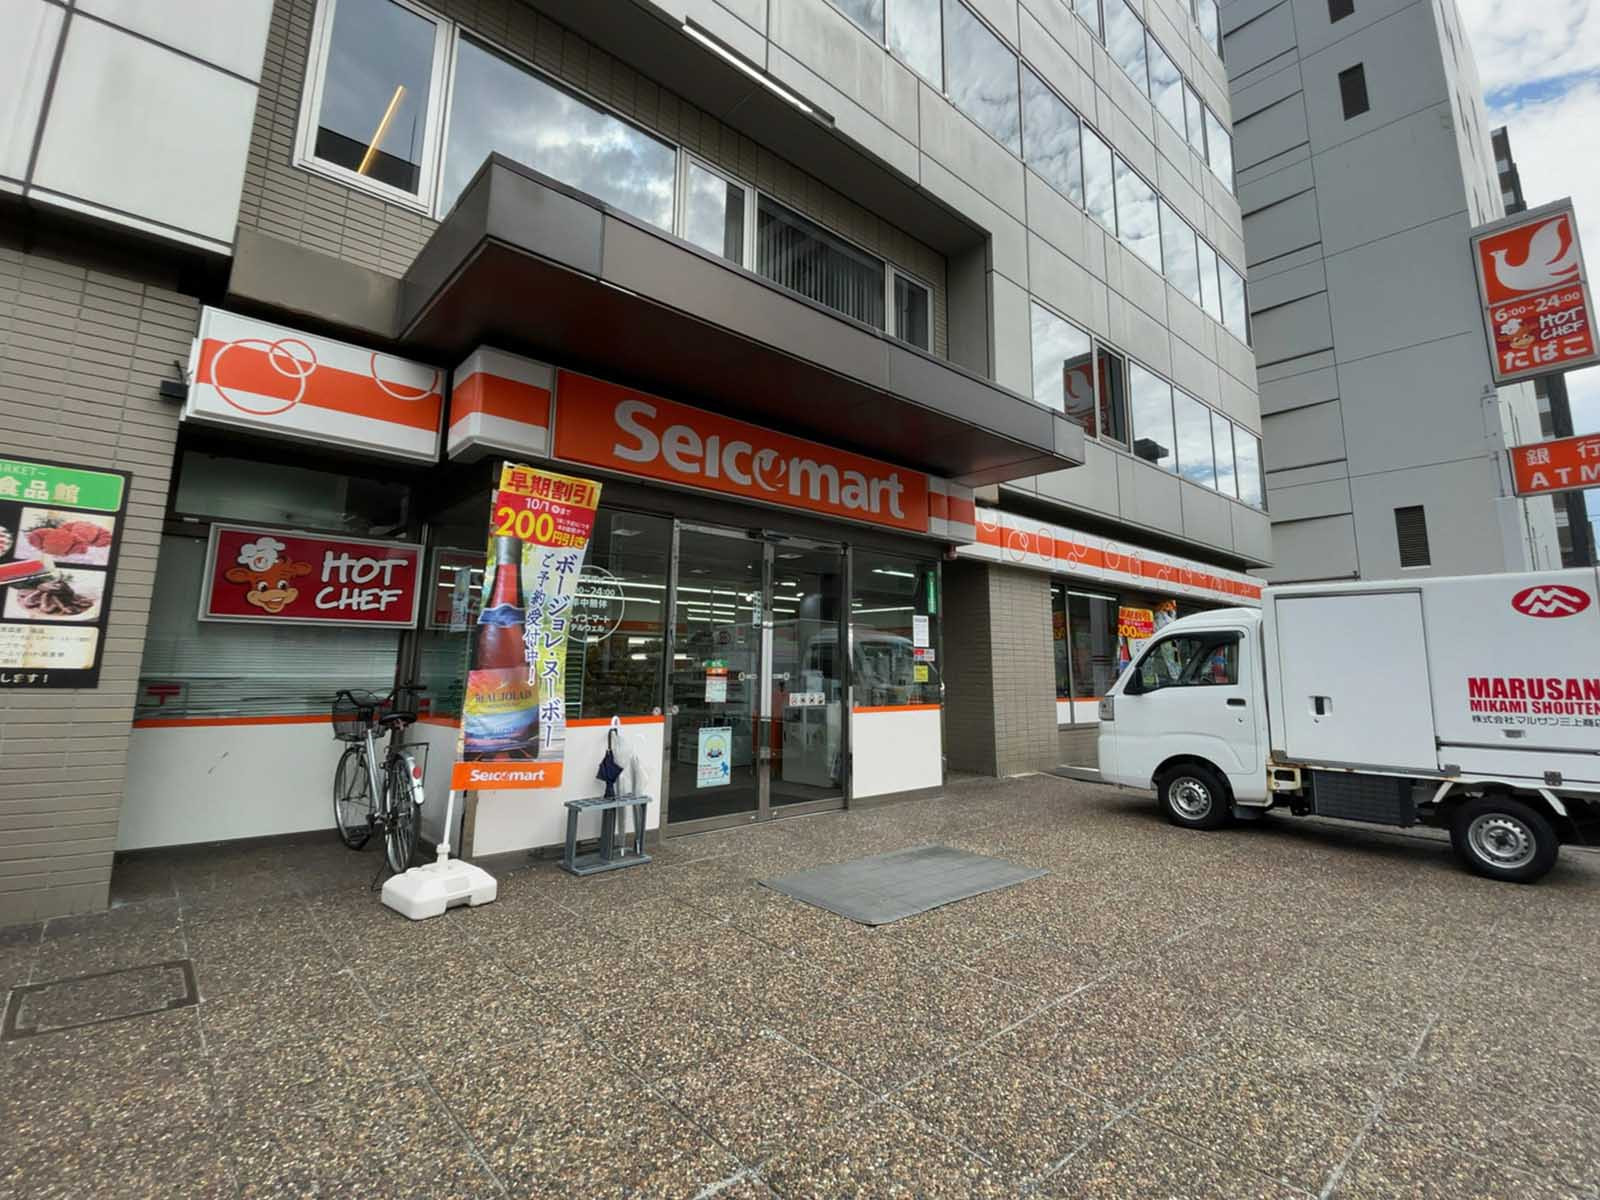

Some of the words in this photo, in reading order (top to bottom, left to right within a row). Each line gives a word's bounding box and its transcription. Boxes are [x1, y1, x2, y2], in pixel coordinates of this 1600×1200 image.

[1539, 306, 1583, 331] HOT
[1540, 321, 1585, 341] CHEF
[1503, 336, 1588, 370] たばこ
[612, 399, 905, 519] Seicomart
[506, 470, 595, 507] 早期割引
[1530, 463, 1600, 489] ATM
[321, 550, 409, 586] HOT
[314, 586, 403, 611] CHEF
[1467, 677, 1600, 701] MARUSAN
[1470, 700, 1528, 714] MIKAMI
[470, 769, 545, 782] Seicomart
